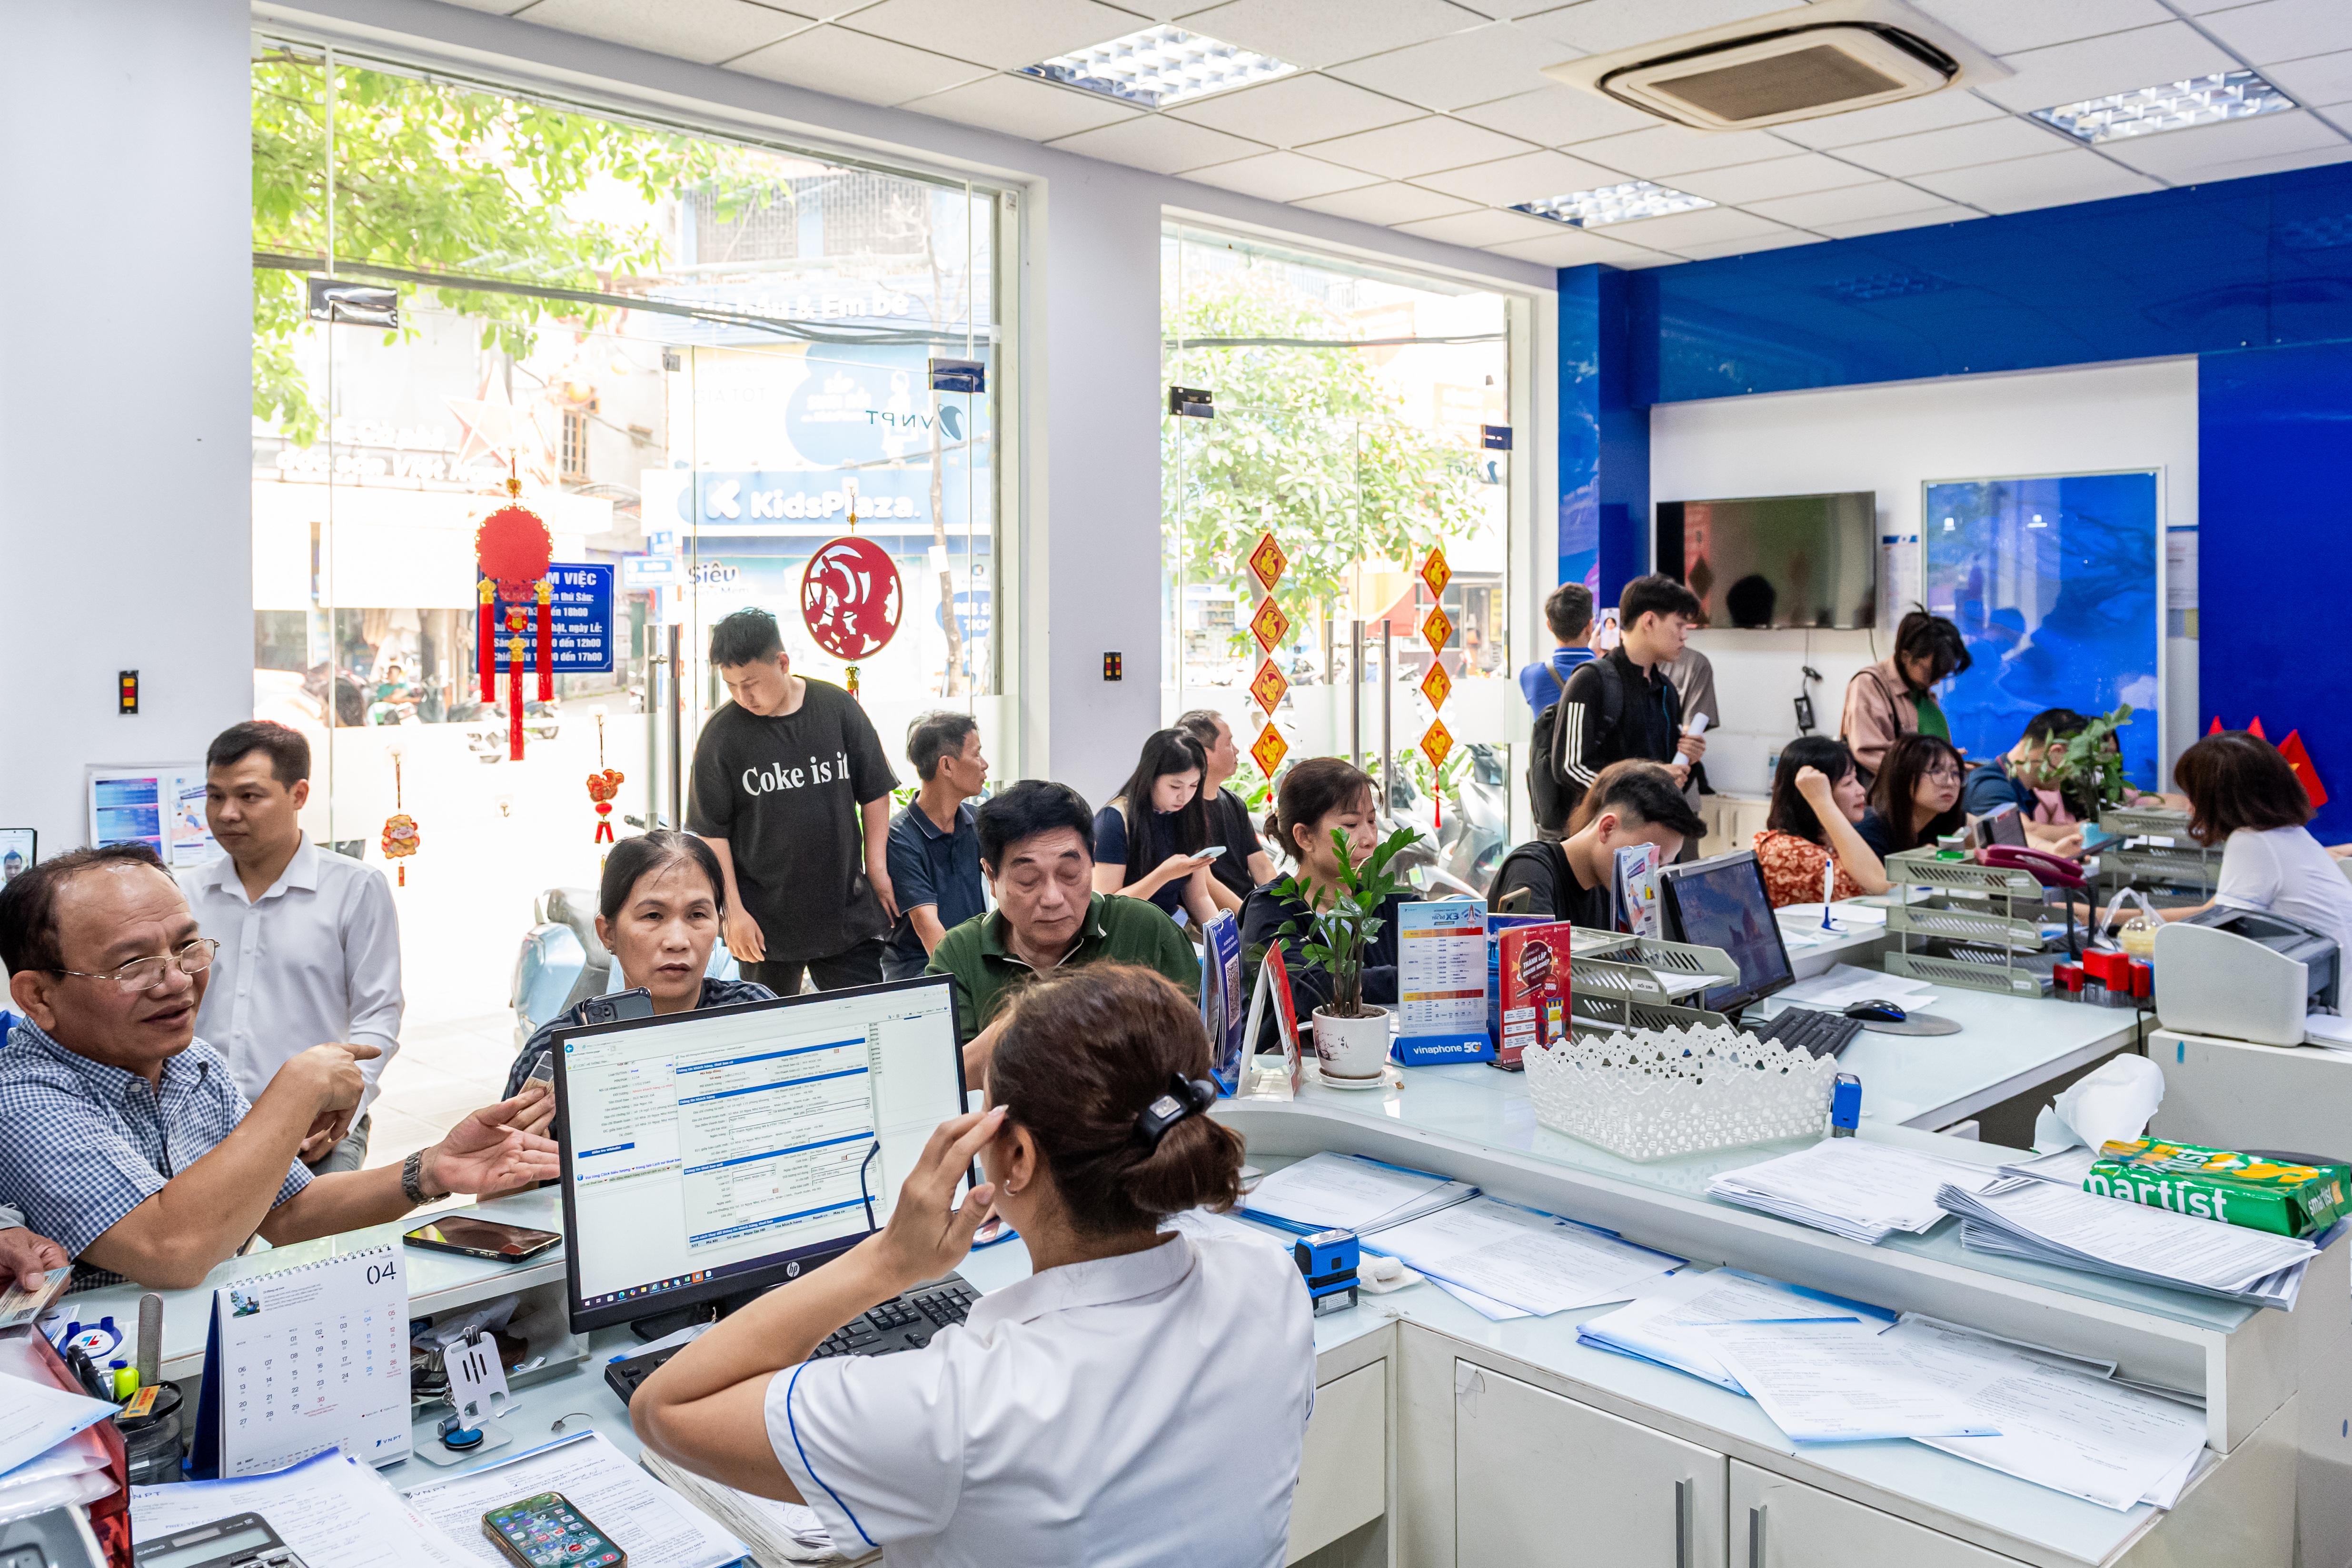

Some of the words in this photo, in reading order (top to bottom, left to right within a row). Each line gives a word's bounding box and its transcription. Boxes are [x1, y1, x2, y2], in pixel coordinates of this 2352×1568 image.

[795, 294, 815, 320] &
[822, 294, 867, 319] Em
[873, 289, 910, 316] bé
[565, 570, 597, 588] VIỆC
[688, 562, 736, 584] Siêu
[569, 623, 588, 634] ngày
[559, 636, 575, 648] đến
[576, 638, 601, 648] 12h00
[560, 650, 576, 662] đến
[578, 652, 603, 662] 17h00
[742, 762, 805, 796] Coke
[810, 756, 832, 784] is
[1446, 913, 1459, 921] X3
[1523, 956, 1538, 969] THÀNH
[1538, 951, 1547, 962] LẬP
[1413, 1044, 1462, 1055] vinaphone
[2308, 1187, 2334, 1217] smartist
[367, 1261, 397, 1285] 04
[789, 1264, 799, 1277] hp
[383, 1434, 402, 1444] VNPT
[413, 1485, 447, 1496] VNPT
[137, 1545, 165, 1557] CASIO
